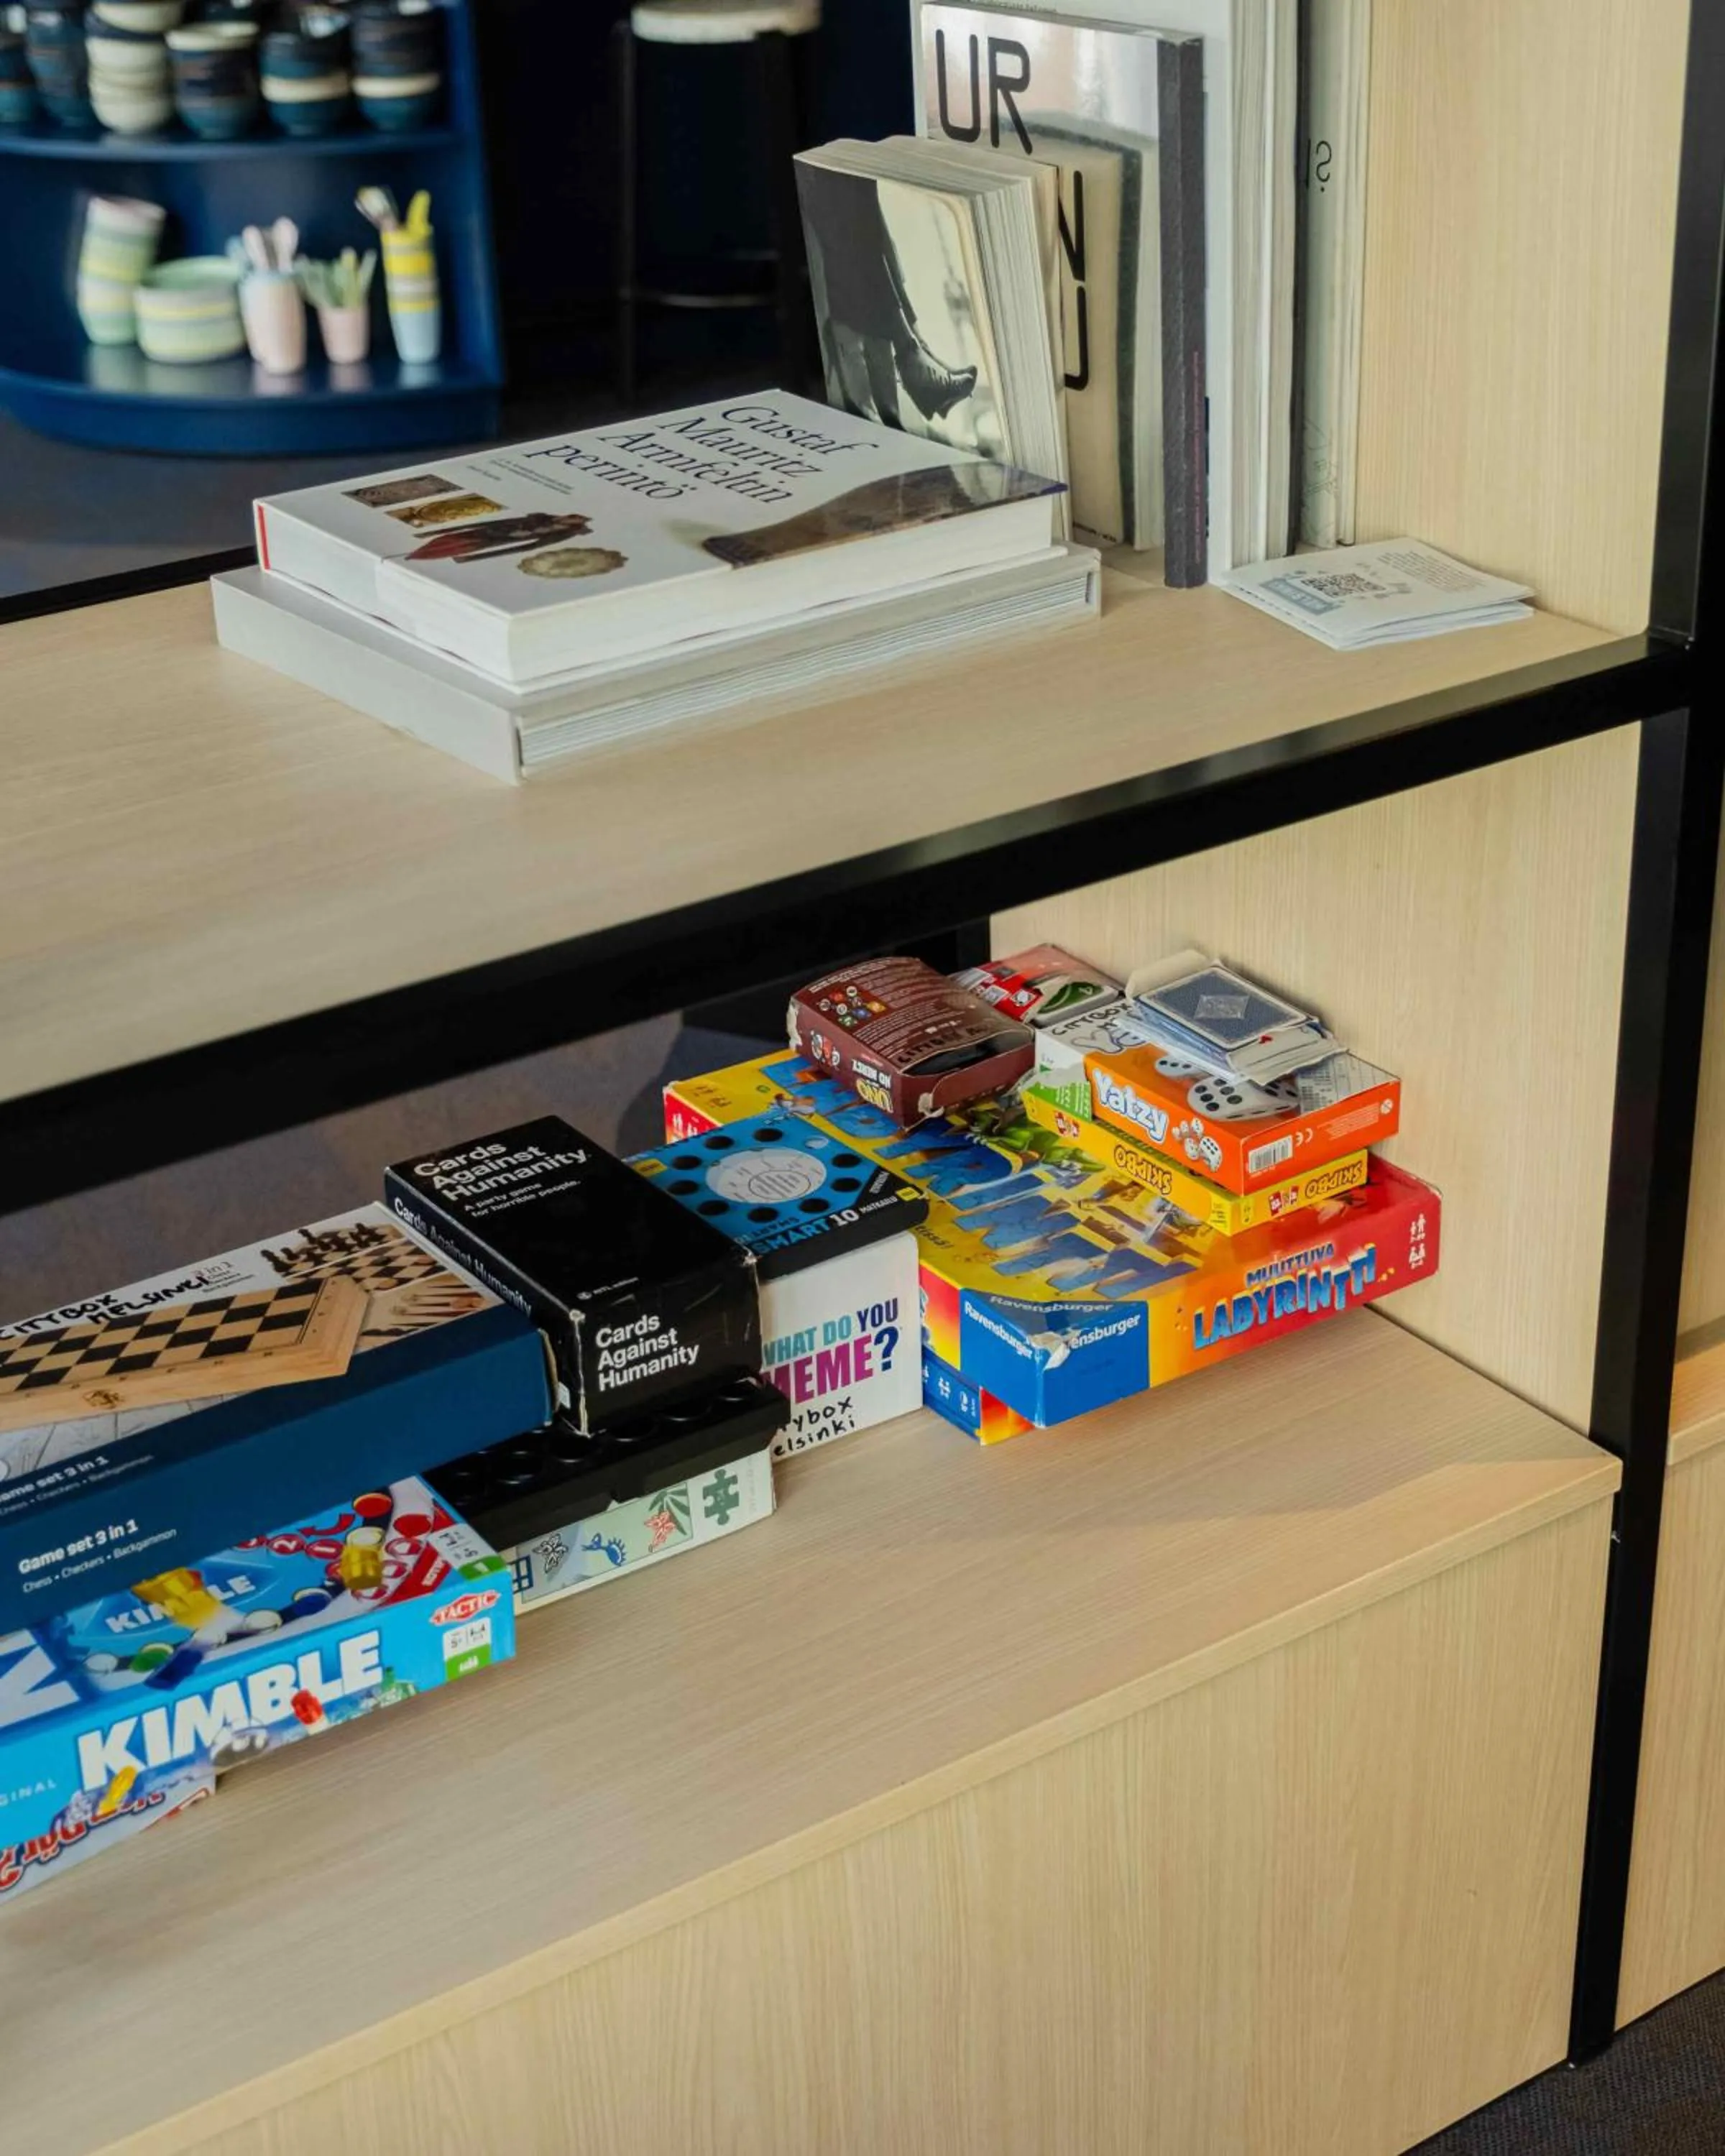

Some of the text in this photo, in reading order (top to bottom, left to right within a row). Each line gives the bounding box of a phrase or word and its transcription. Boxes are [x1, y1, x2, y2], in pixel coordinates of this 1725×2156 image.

[936, 29, 1033, 155] UR
[656, 416, 823, 479] Mauritz
[721, 406, 879, 456] Gustaf
[523, 445, 697, 499] perintö
[598, 430, 794, 504] Armfeltin
[1092, 1068, 1169, 1144] Yatzy
[414, 1143, 507, 1176] Cards
[432, 1146, 546, 1189] Against
[441, 1149, 588, 1201] Humanity
[471, 1209, 489, 1217] for
[492, 1192, 536, 1212] horrible
[476, 1194, 507, 1208] party
[510, 1183, 542, 1199] game
[754, 1209, 860, 1253] SMART 10
[395, 1197, 428, 1235] Cards
[474, 1258, 532, 1317] Humanity
[1246, 1243, 1334, 1287] MUUTTUVA
[990, 1295, 1113, 1312] Ravensburger
[1193, 1243, 1376, 1350] LABYRINTTI
[595, 1314, 661, 1348] Cards
[823, 1314, 852, 1346] DO
[857, 1298, 898, 1332] YOU
[964, 1301, 1033, 1360] Ravensburger
[1070, 1314, 1141, 1350] ensburger
[597, 1327, 678, 1370] Against
[599, 1345, 699, 1392] Humanity
[773, 1414, 855, 1457] elsinki
[0, 1455, 109, 1503] ame set 3 in 1
[17, 1519, 139, 1575] Game set 3 in 1
[22, 1529, 178, 1593] Chess Checkers Backgammon
[437, 1592, 496, 1623] TACTIC
[77, 1629, 382, 1792] KIMBLE
